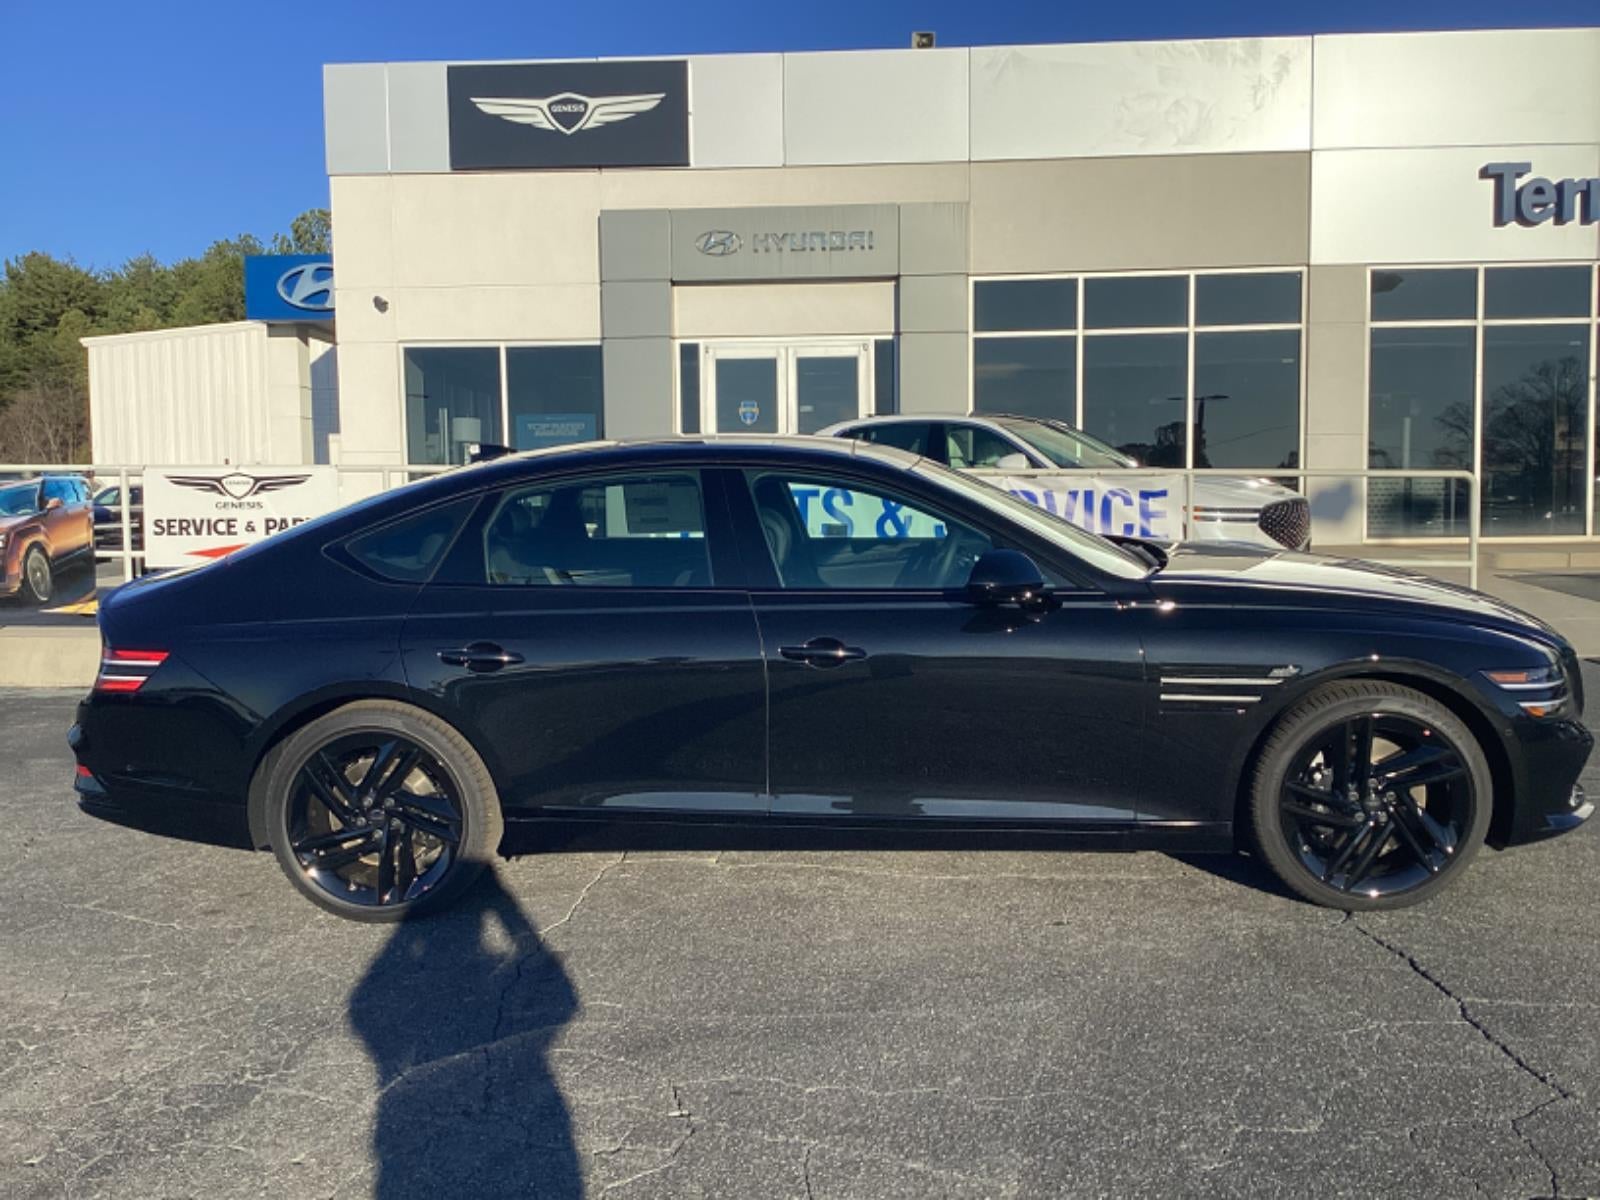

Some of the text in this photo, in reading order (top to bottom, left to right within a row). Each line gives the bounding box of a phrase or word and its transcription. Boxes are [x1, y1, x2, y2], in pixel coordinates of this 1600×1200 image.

[753, 231, 874, 253] HYUNDAI
[215, 501, 263, 510] GENESIS
[153, 517, 311, 536] SERVICE & PA
